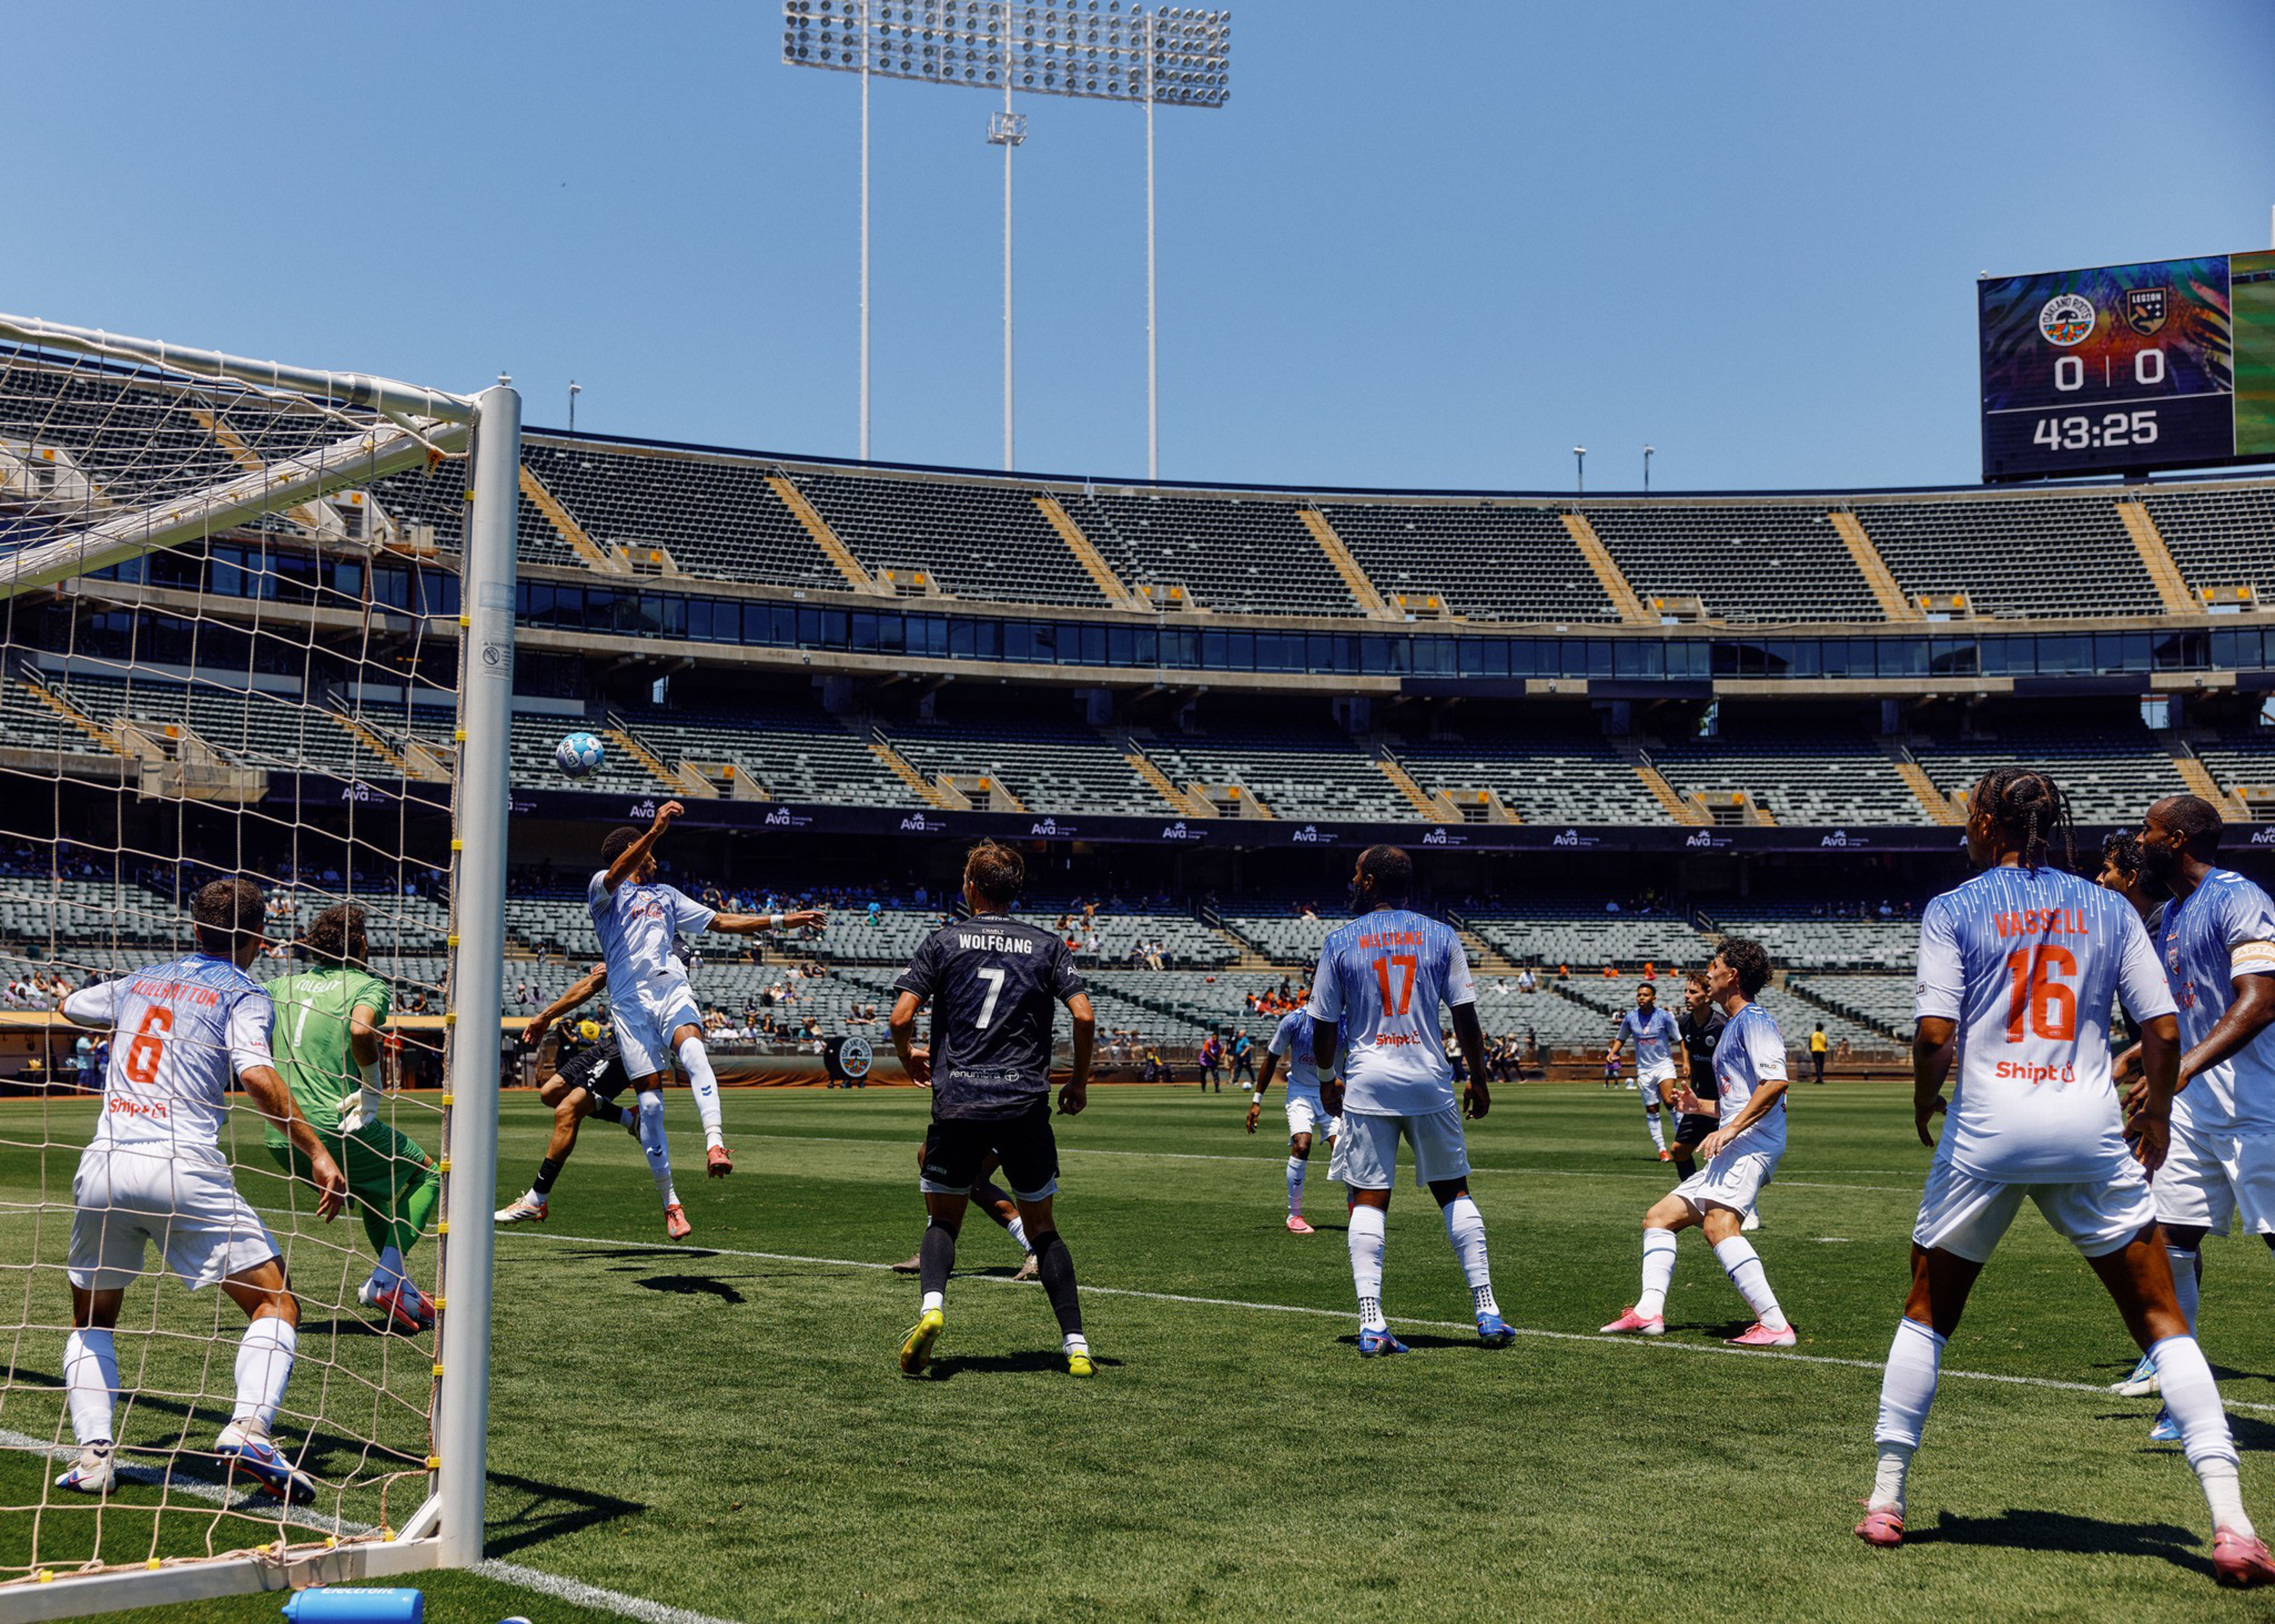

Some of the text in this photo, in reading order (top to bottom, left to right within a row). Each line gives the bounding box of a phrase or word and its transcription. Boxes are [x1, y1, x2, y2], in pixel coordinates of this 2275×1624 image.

[2132, 293, 2162, 303] LEGION
[2043, 298, 2092, 323] OAKLAND ROOTS
[2054, 348, 2165, 391] 0 0
[2033, 410, 2158, 451] 43:25
[562, 740, 579, 766] SELECT
[342, 788, 369, 801] Ava
[630, 805, 655, 818] Ava
[765, 813, 790, 824] Ava
[901, 819, 925, 830] Ava
[1031, 824, 1056, 835] Ava
[1162, 827, 1186, 839] Ava
[1293, 830, 1316, 842] Ava
[1422, 833, 1446, 844] Ava
[1553, 835, 1578, 846] Ava
[1686, 836, 1710, 846] Ava
[1821, 836, 1847, 846] Ava
[1994, 907, 2089, 938] VASSELL
[959, 934, 1032, 954] WOLFGANG
[1358, 932, 1422, 949] WILLIAMS
[1373, 955, 1417, 1017] 17
[2006, 945, 2077, 1043] 16
[975, 967, 1005, 1029] 7
[293, 996, 313, 1047] 1
[126, 1005, 173, 1084] 6
[1376, 1032, 1409, 1048] Shipt
[1995, 1061, 2058, 1084] Shipt
[108, 1098, 149, 1118] Shipt
